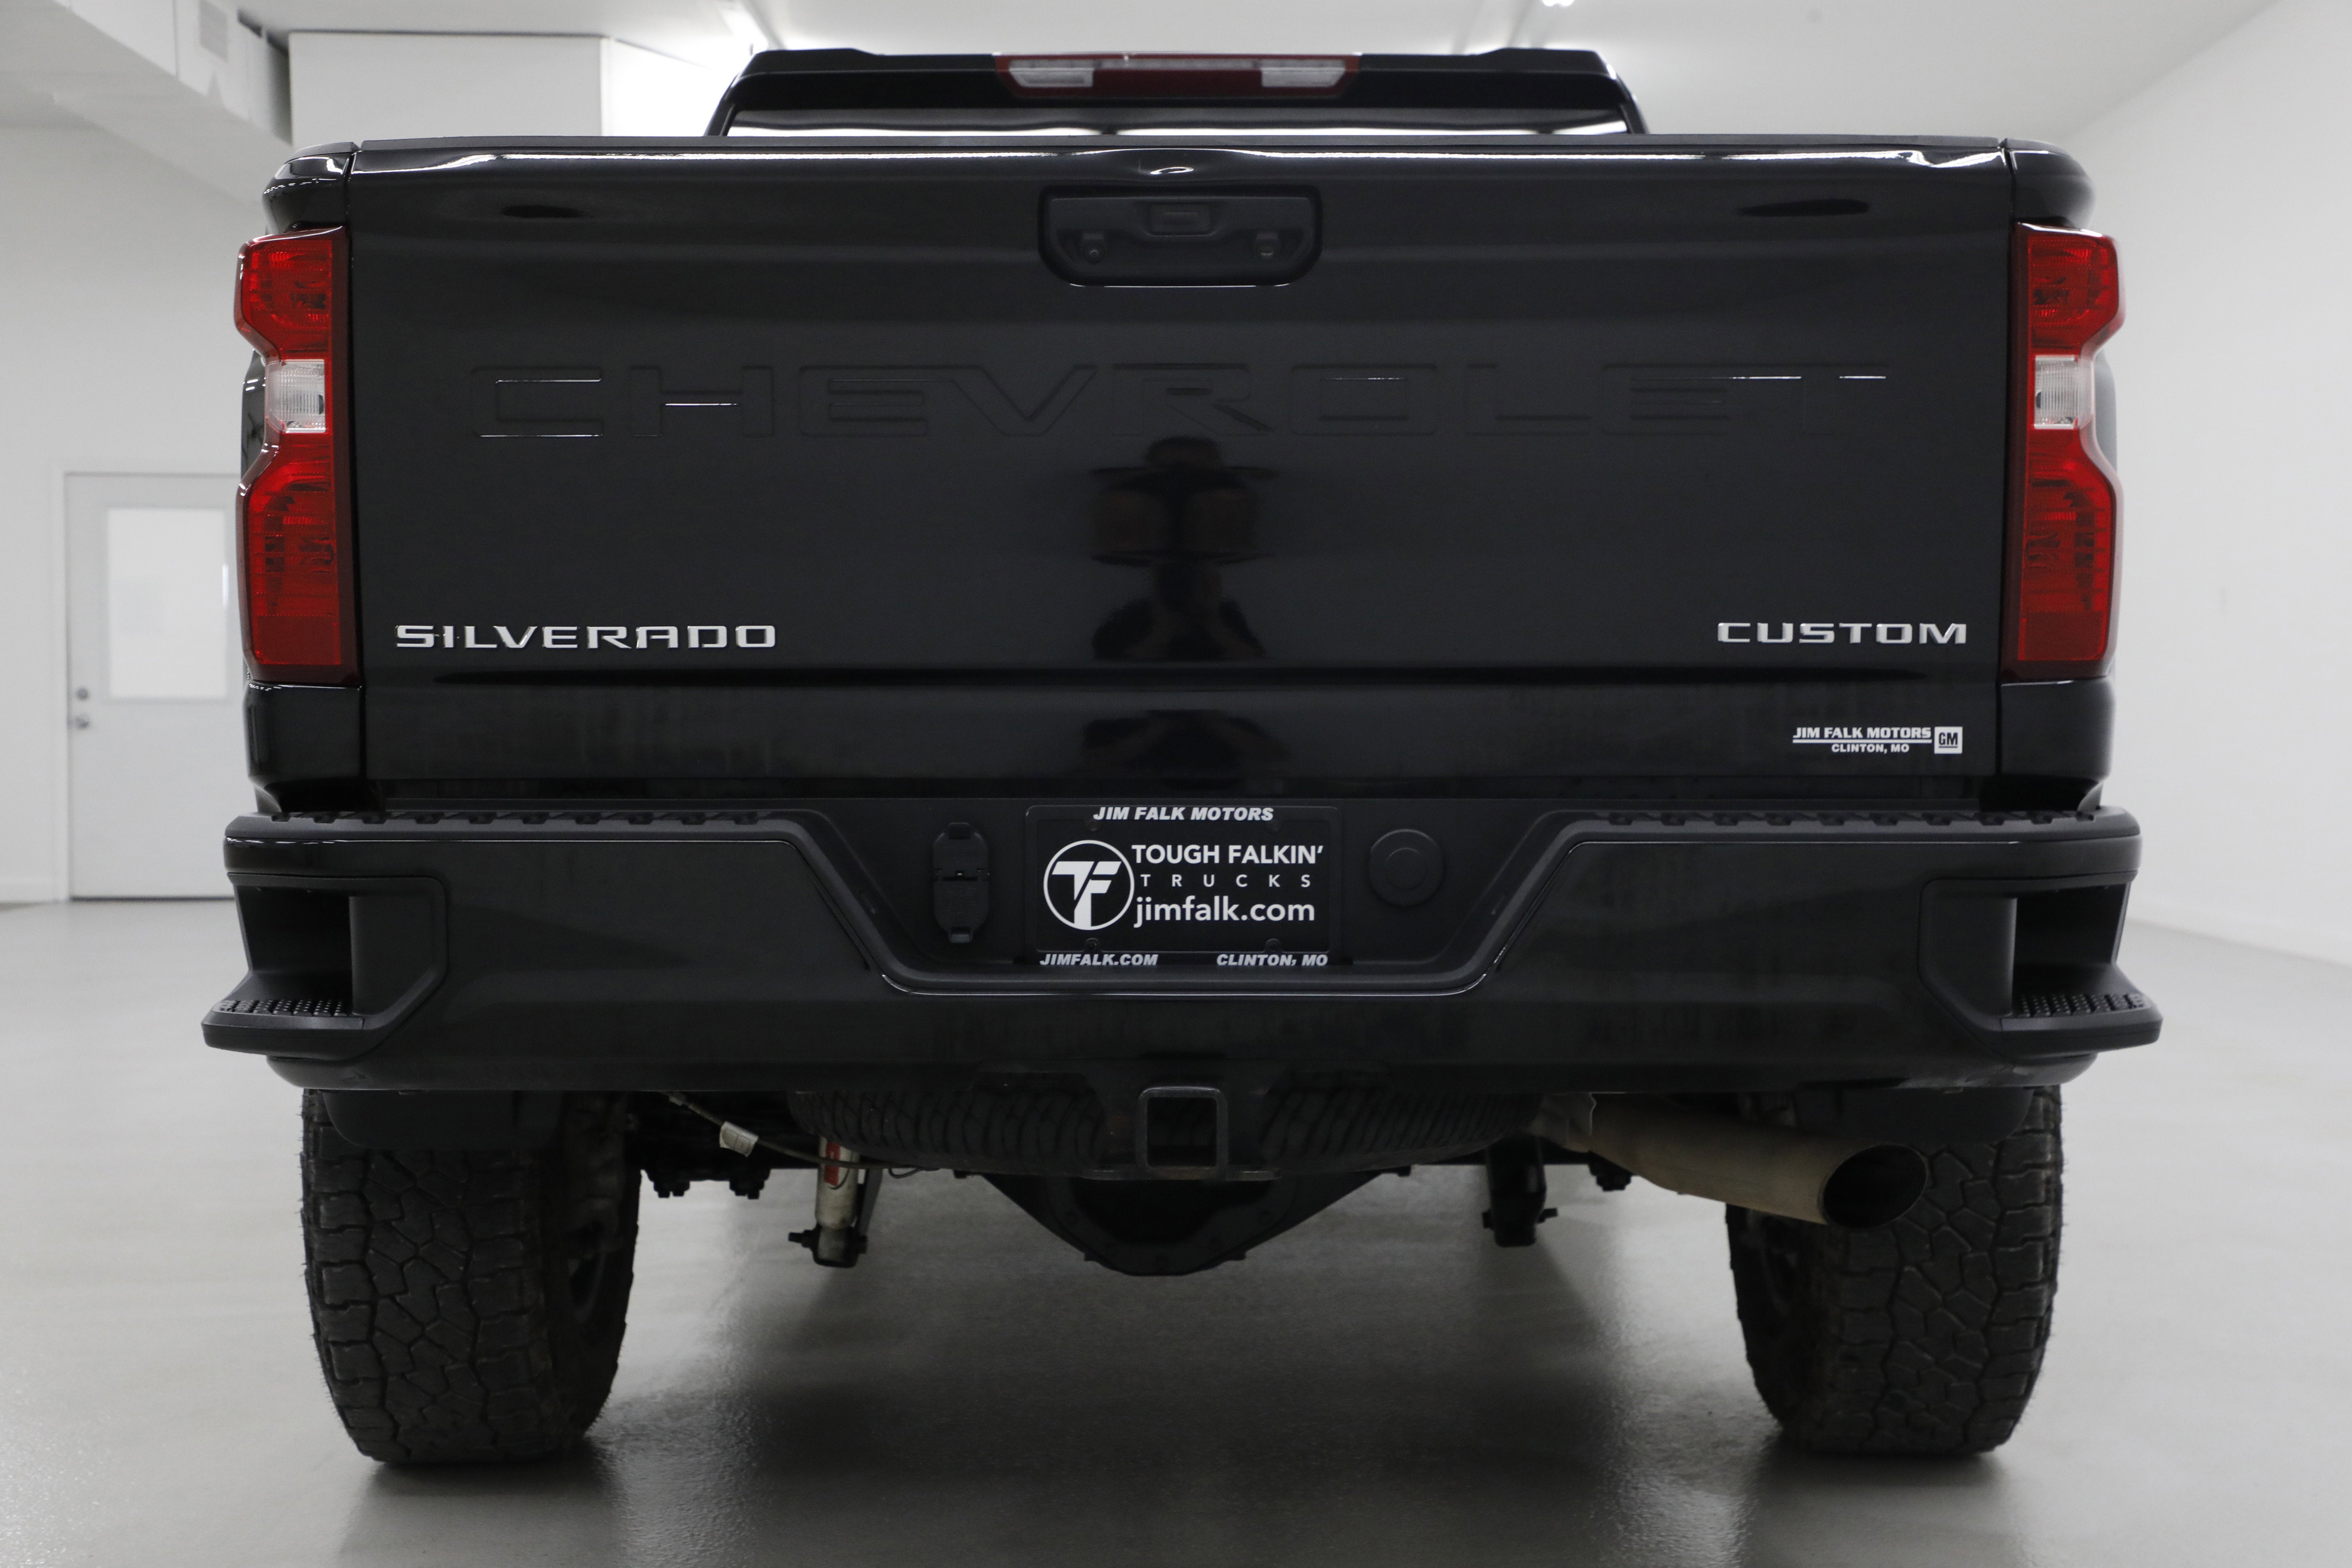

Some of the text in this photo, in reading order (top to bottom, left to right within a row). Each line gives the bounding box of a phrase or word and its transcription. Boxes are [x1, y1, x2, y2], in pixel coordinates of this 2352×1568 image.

[470, 365, 1891, 437] CHEVROLET
[395, 625, 775, 648] SILVERADO
[1717, 622, 1967, 644] CUSTOM
[1793, 727, 1931, 739] JIM FALK MOTORS
[1939, 732, 1958, 746] GM
[1831, 744, 1910, 754] CLINTON, MO
[1093, 806, 1274, 821] JIM FALK MOTORS
[1131, 844, 1324, 864] TOUGH FALKIN'
[1140, 874, 1310, 888] TRUCKS
[1134, 896, 1315, 928] jimfalk.com
[1040, 953, 1158, 966] JIMFALK.COM
[1216, 954, 1328, 967] CLINTON, MO
